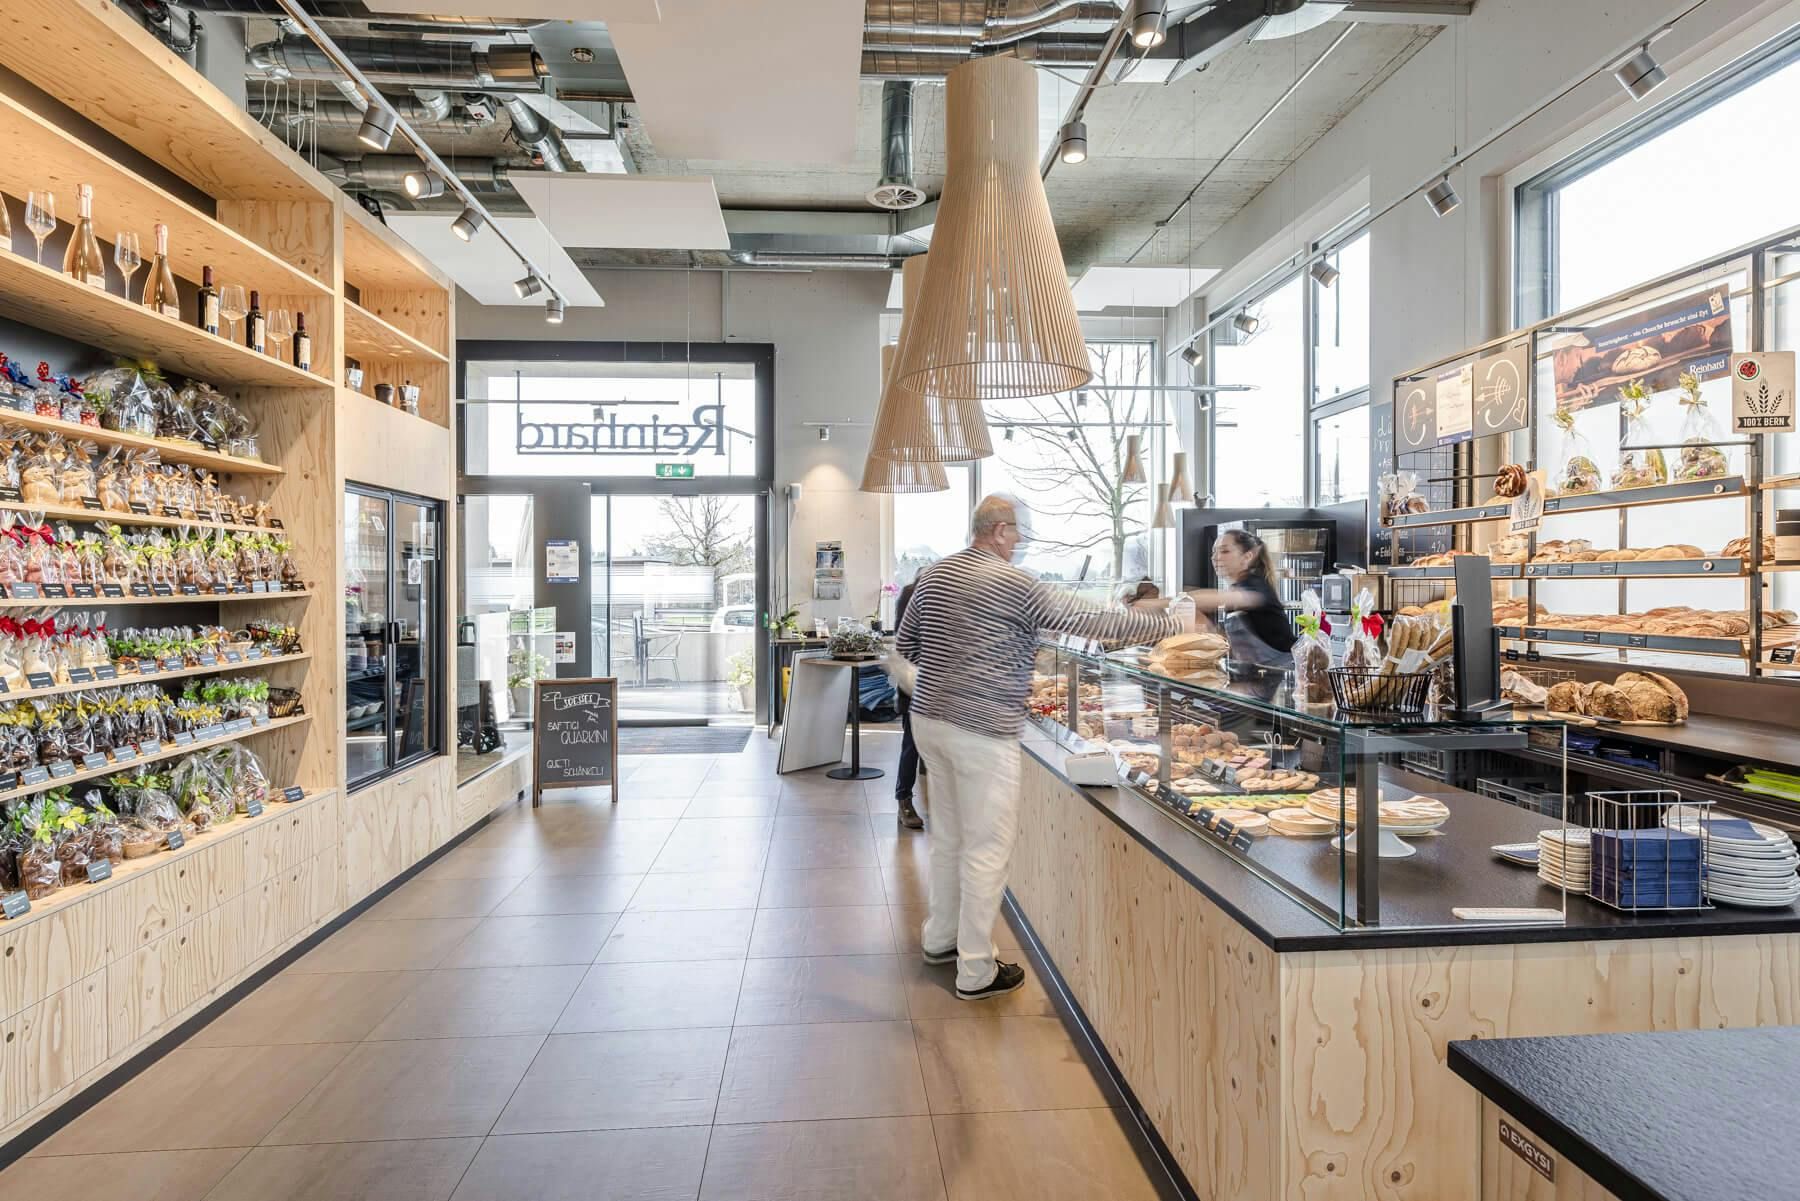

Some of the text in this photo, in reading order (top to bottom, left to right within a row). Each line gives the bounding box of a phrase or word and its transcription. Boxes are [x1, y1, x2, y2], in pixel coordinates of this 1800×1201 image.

[1689, 359, 1726, 374] Reinhard
[1743, 416, 1785, 427] 100% BERN
[1510, 1130, 1551, 1172] EXGYSI
